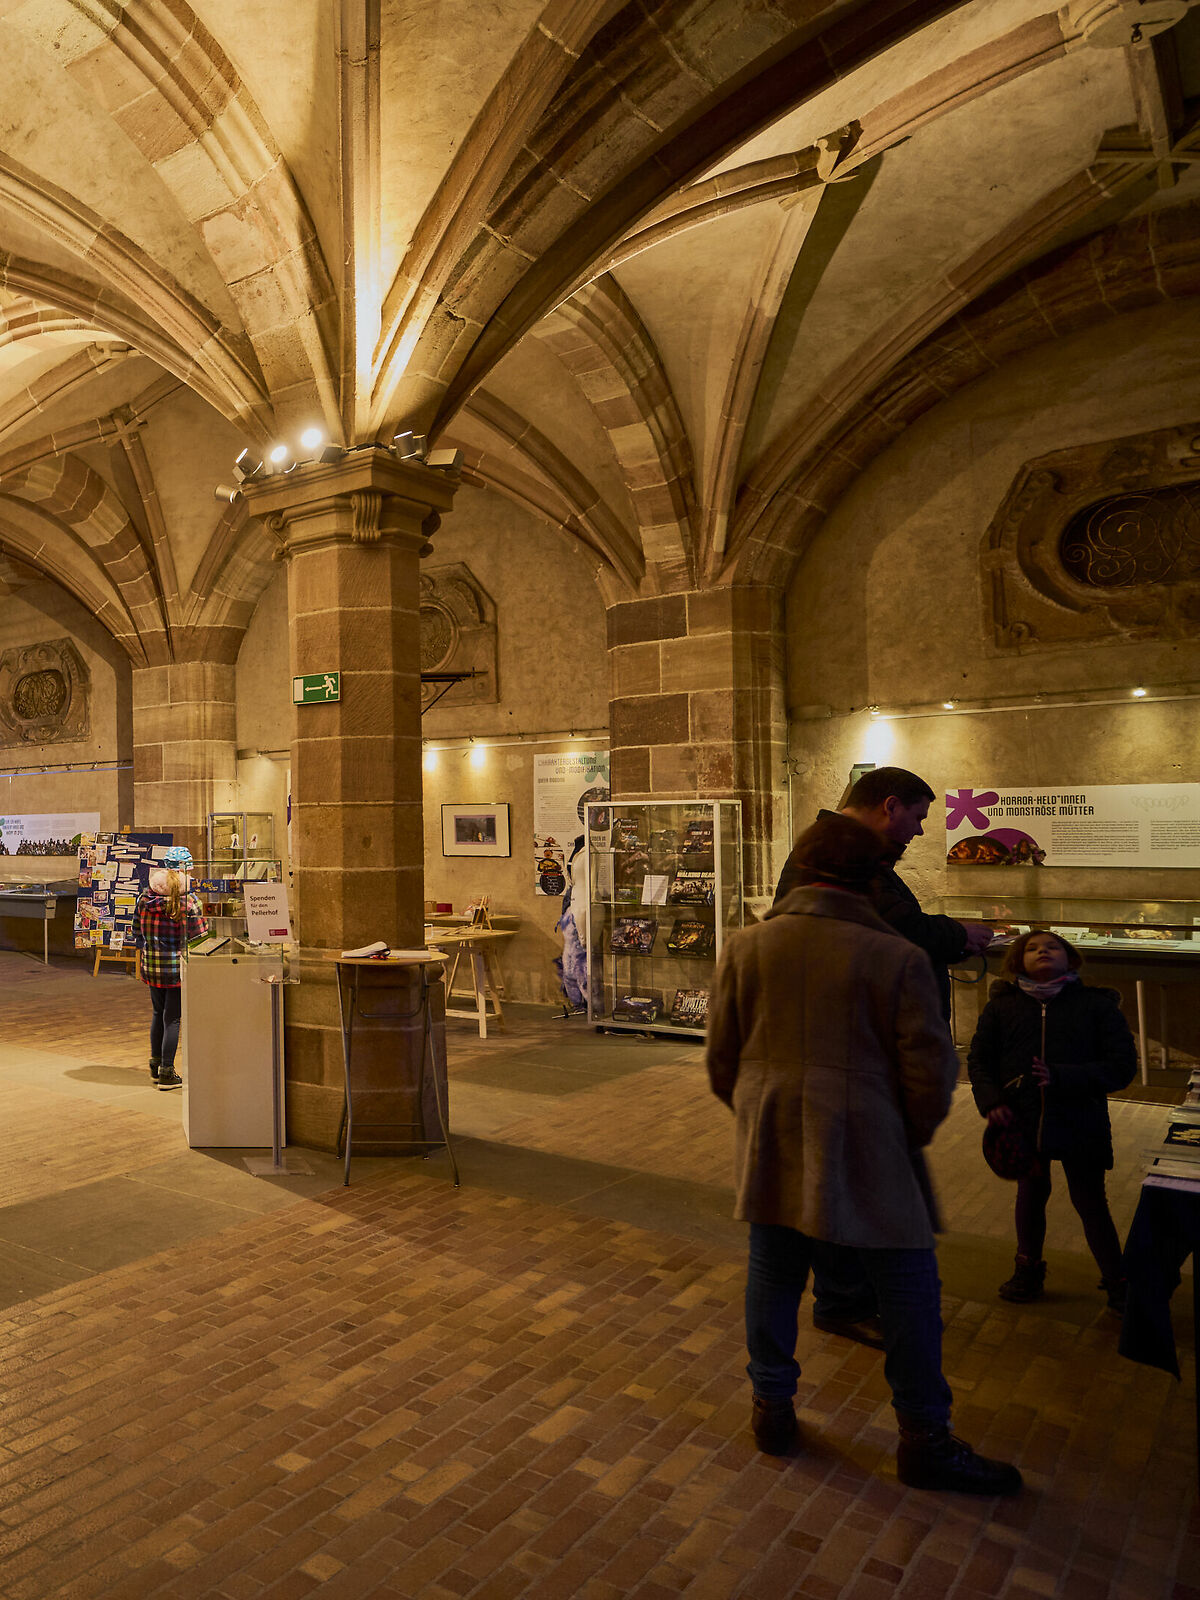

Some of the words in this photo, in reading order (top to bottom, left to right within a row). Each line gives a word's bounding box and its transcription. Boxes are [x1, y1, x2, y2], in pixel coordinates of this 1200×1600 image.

[987, 807, 1004, 817] UND
[1006, 805, 1057, 817] MONSTRÖSE
[1059, 804, 1095, 816] MÜTTER
[682, 996, 708, 1009] WINTER
